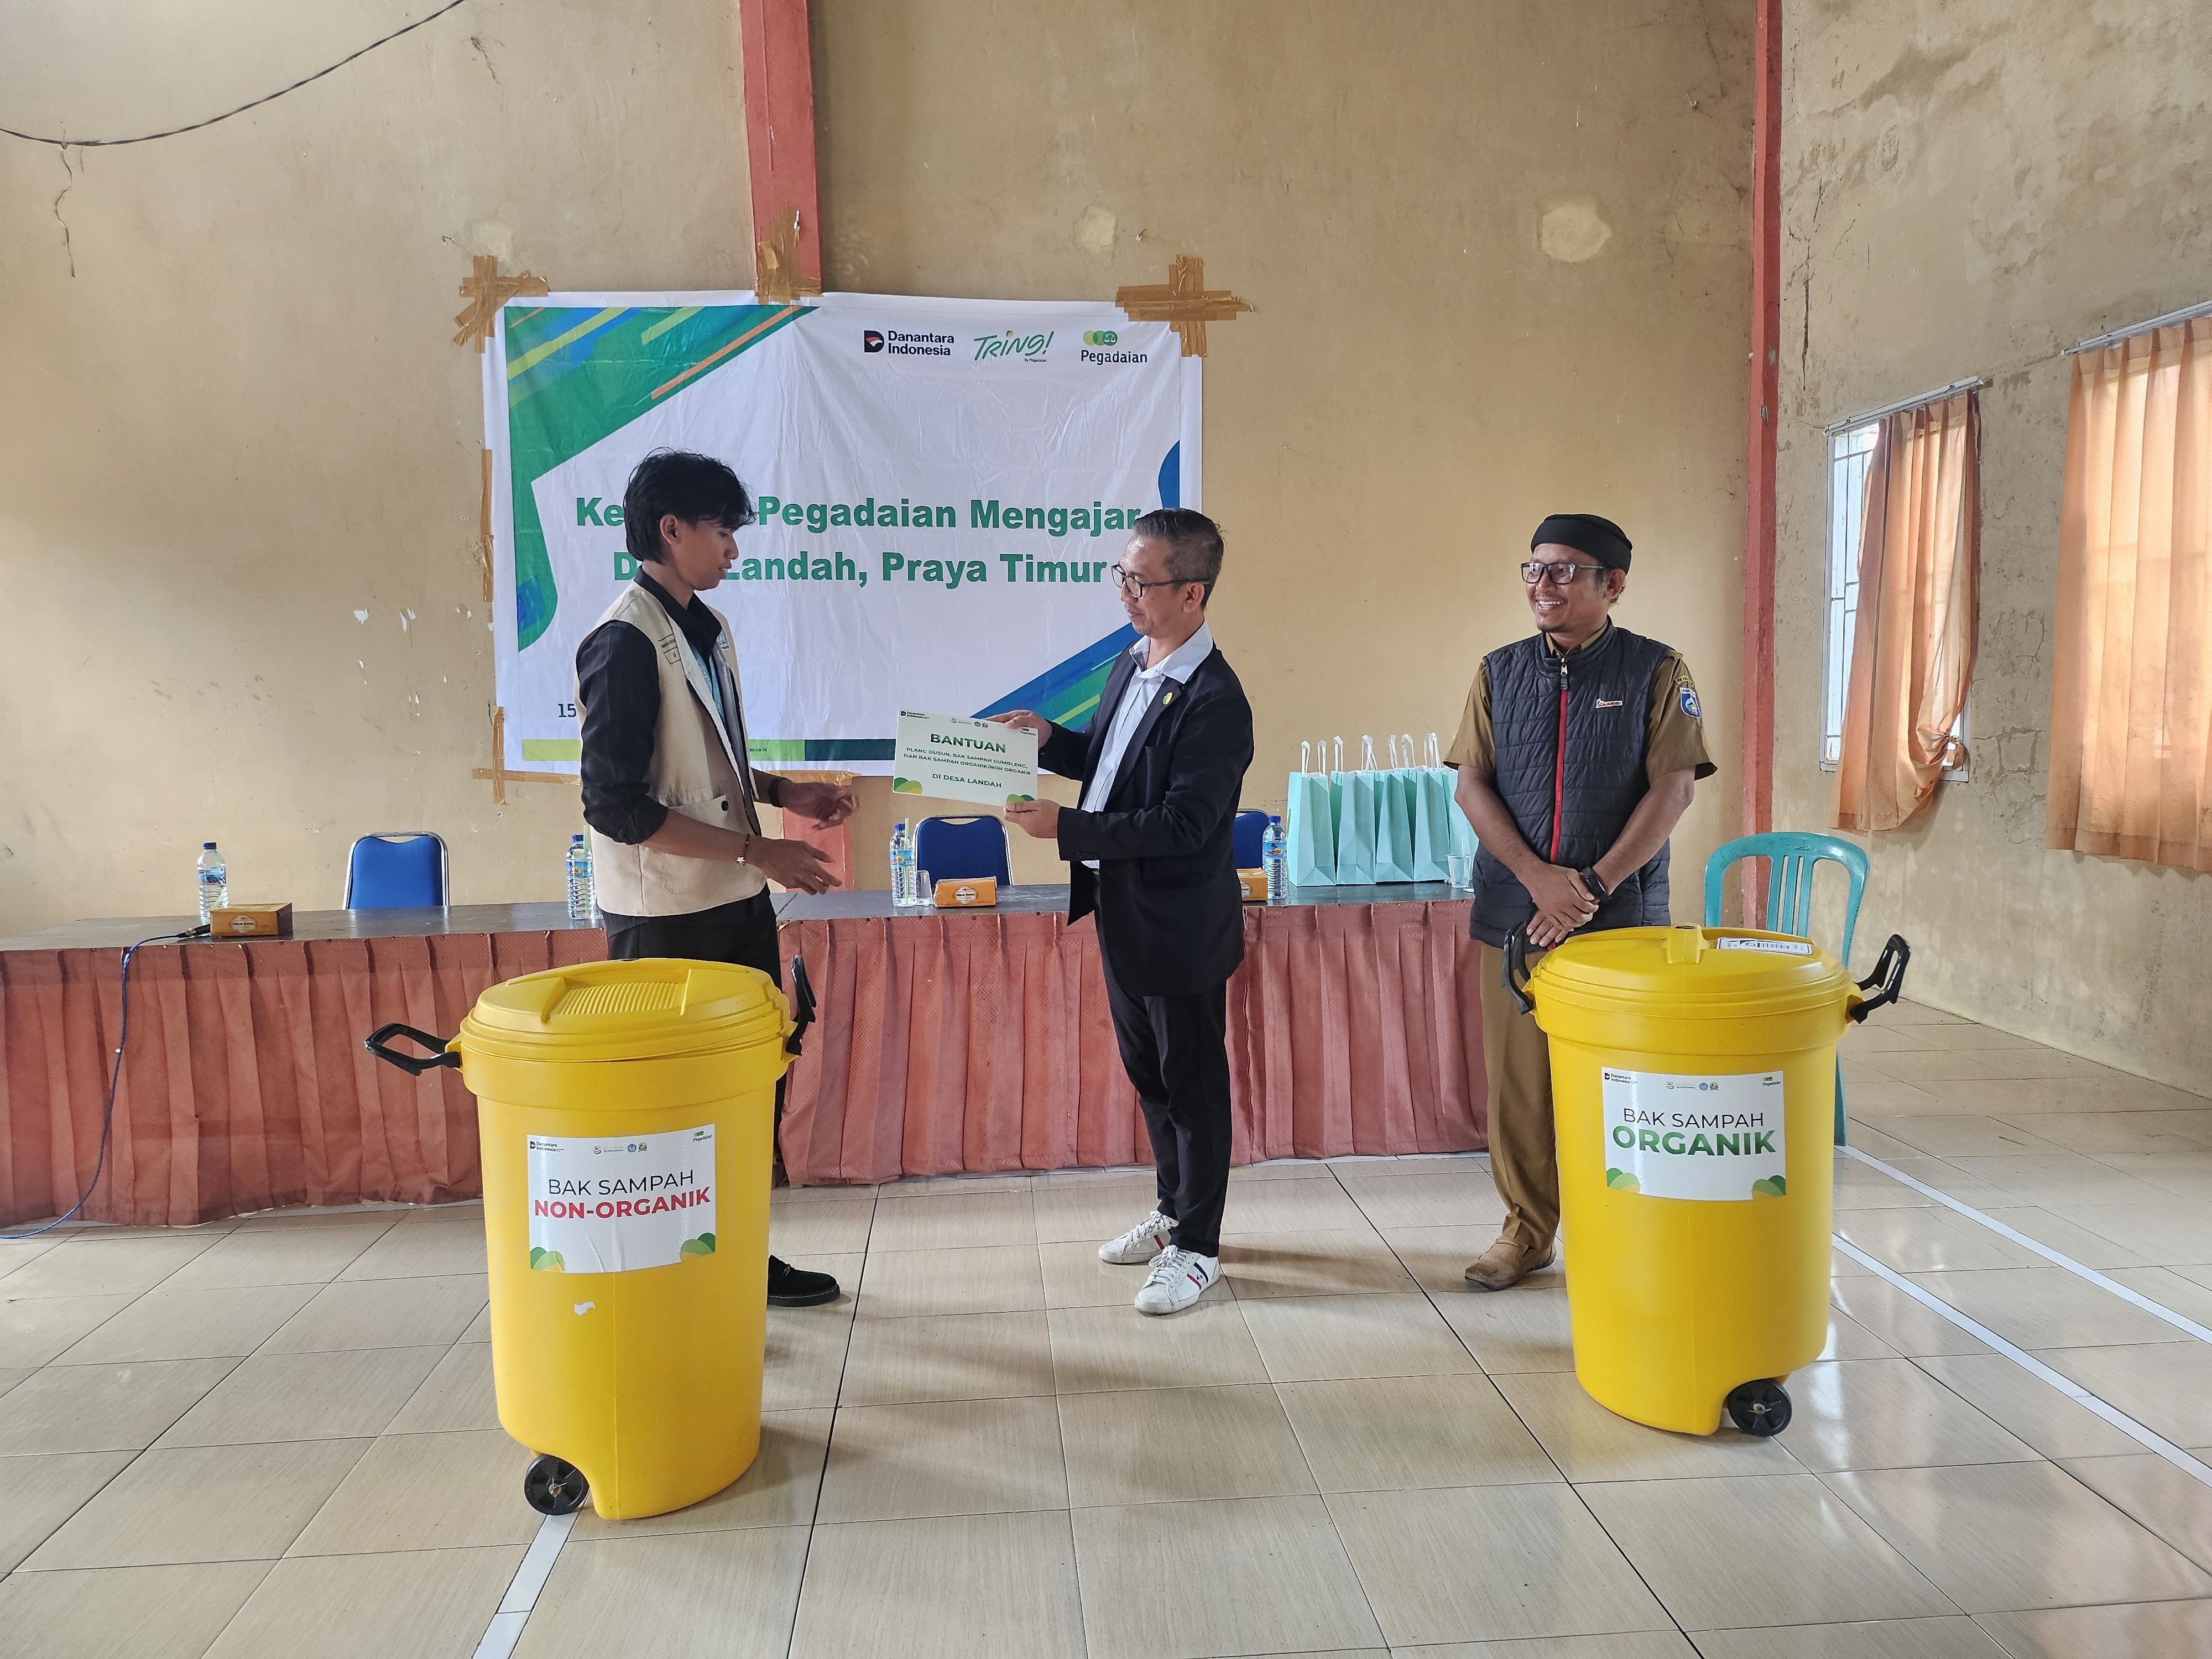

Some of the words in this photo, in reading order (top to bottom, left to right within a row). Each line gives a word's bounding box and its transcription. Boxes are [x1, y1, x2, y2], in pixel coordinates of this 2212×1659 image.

[888, 331, 954, 343] Danantara
[888, 343, 951, 356] Indonesia
[1081, 350, 1147, 365] Pegadaian
[759, 497, 956, 534] Pegadaian
[971, 500, 1141, 537] Mengajar
[882, 552, 987, 589] Praya
[1000, 554, 1107, 582] Timur
[559, 703, 576, 717] 15
[931, 733, 1006, 753] BANTUAN
[961, 761, 1003, 771] ORGANIK/NON
[994, 759, 1028, 769] GUMBLENG,
[968, 778, 1001, 788] LANDAH
[1624, 1108, 1666, 1126] BAK
[1672, 1112, 1764, 1129] SAMPAH
[1613, 1125, 1776, 1156] ORGANIK
[549, 1179, 592, 1196] BAK
[598, 1170, 693, 1195] SAMPAH
[535, 1186, 711, 1219] NON-ORGANIK
